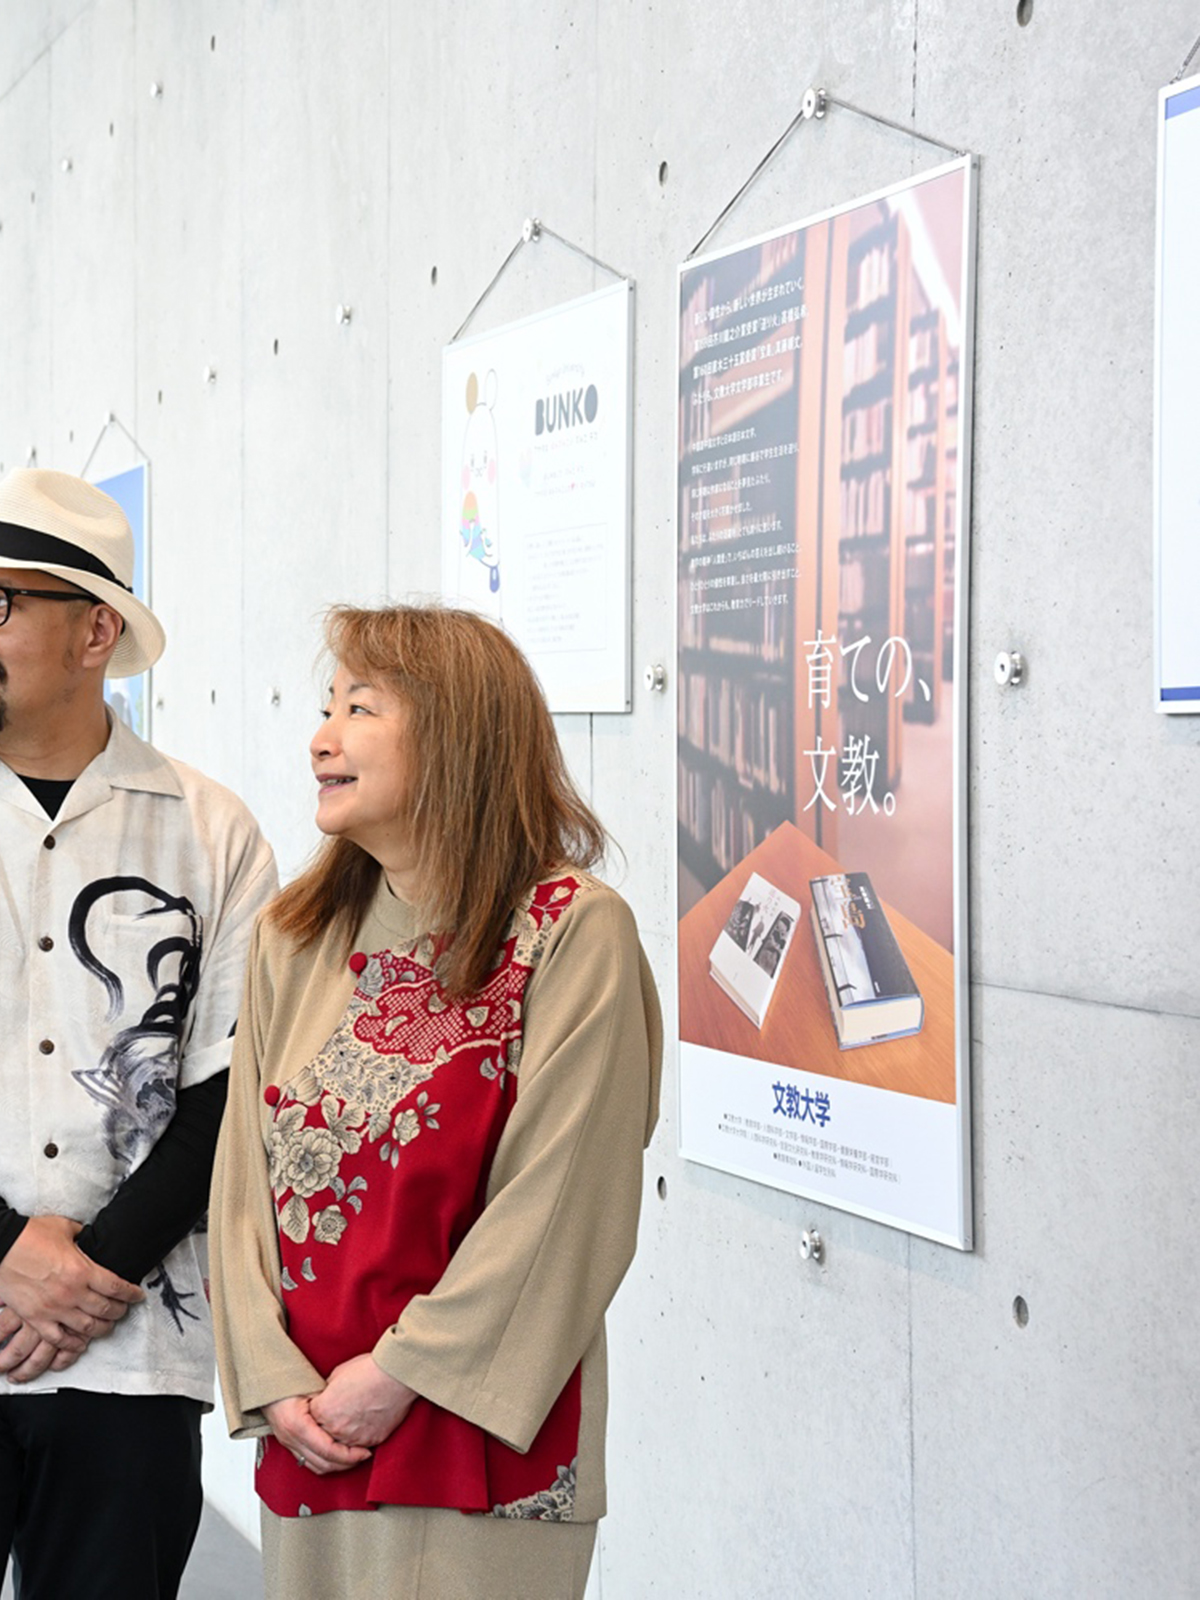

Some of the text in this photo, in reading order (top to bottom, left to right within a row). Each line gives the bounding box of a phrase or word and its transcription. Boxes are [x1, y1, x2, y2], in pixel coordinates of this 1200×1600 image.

[535, 384, 598, 436] BUNKO
[803, 629, 931, 709] 育ての、
[803, 734, 896, 817] 文教。
[772, 1080, 831, 1128] 文教大学
